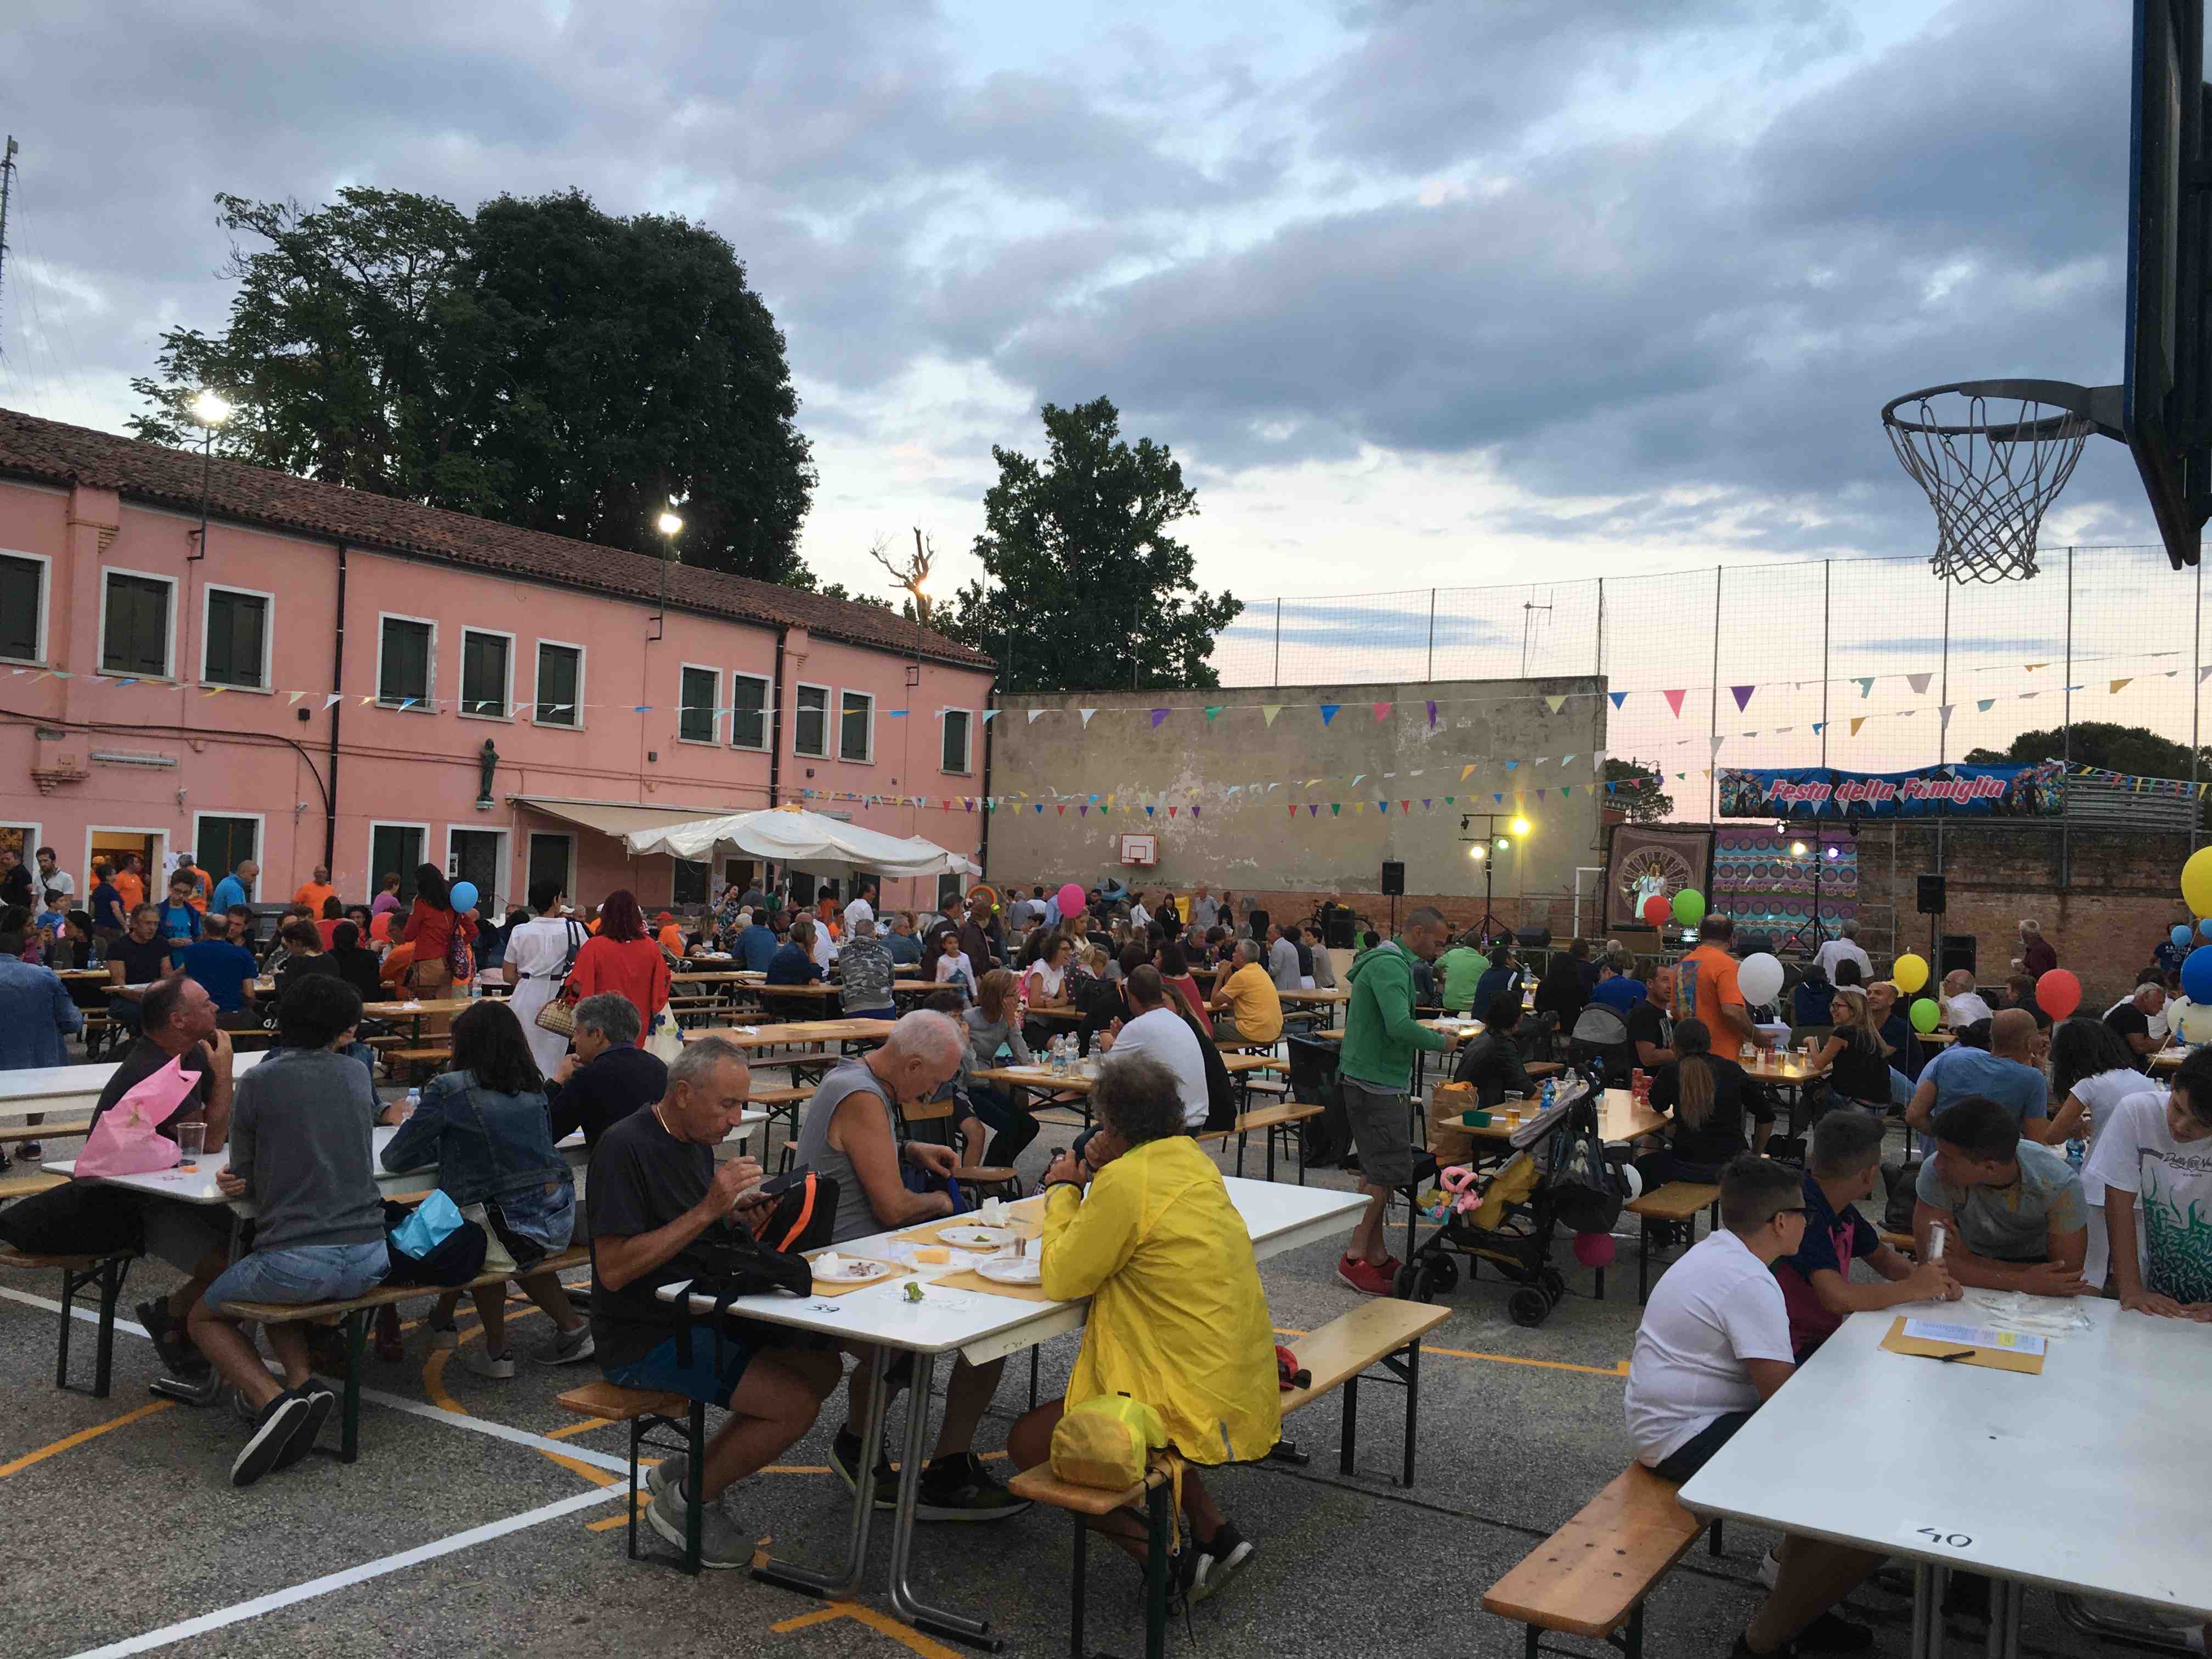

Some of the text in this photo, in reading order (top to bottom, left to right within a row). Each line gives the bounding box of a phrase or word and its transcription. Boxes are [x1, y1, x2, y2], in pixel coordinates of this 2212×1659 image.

[1769, 775, 2006, 804] Festa della Famiglia
[805, 1304, 840, 1313] 39
[1916, 1527, 1973, 1548] 40
